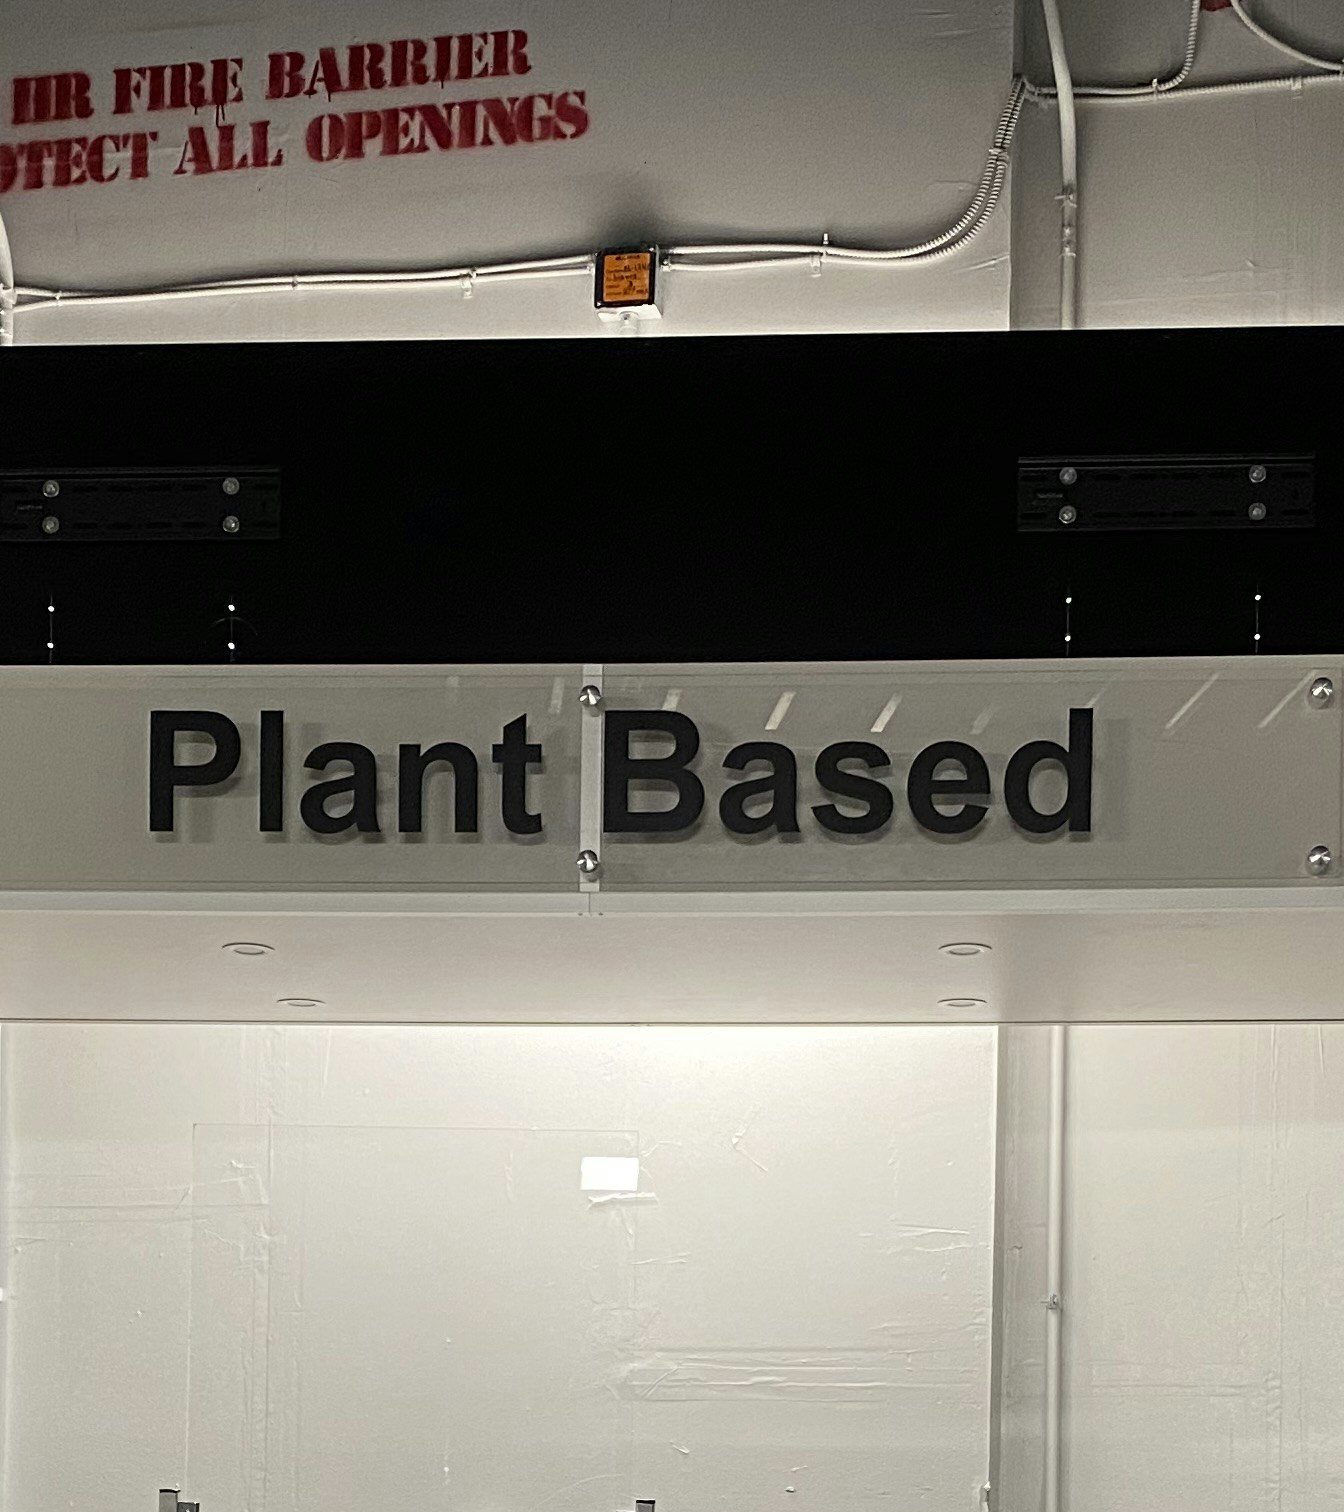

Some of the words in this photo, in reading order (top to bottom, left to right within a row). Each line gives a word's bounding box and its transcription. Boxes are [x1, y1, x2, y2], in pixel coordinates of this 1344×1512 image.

[11, 71, 95, 126] HR
[113, 58, 244, 115] FIRE
[265, 29, 532, 100] BARRIER
[173, 120, 285, 175] ALL
[307, 91, 589, 162] OPENINGS
[148, 709, 544, 835] Plant
[601, 707, 1094, 835] Based
